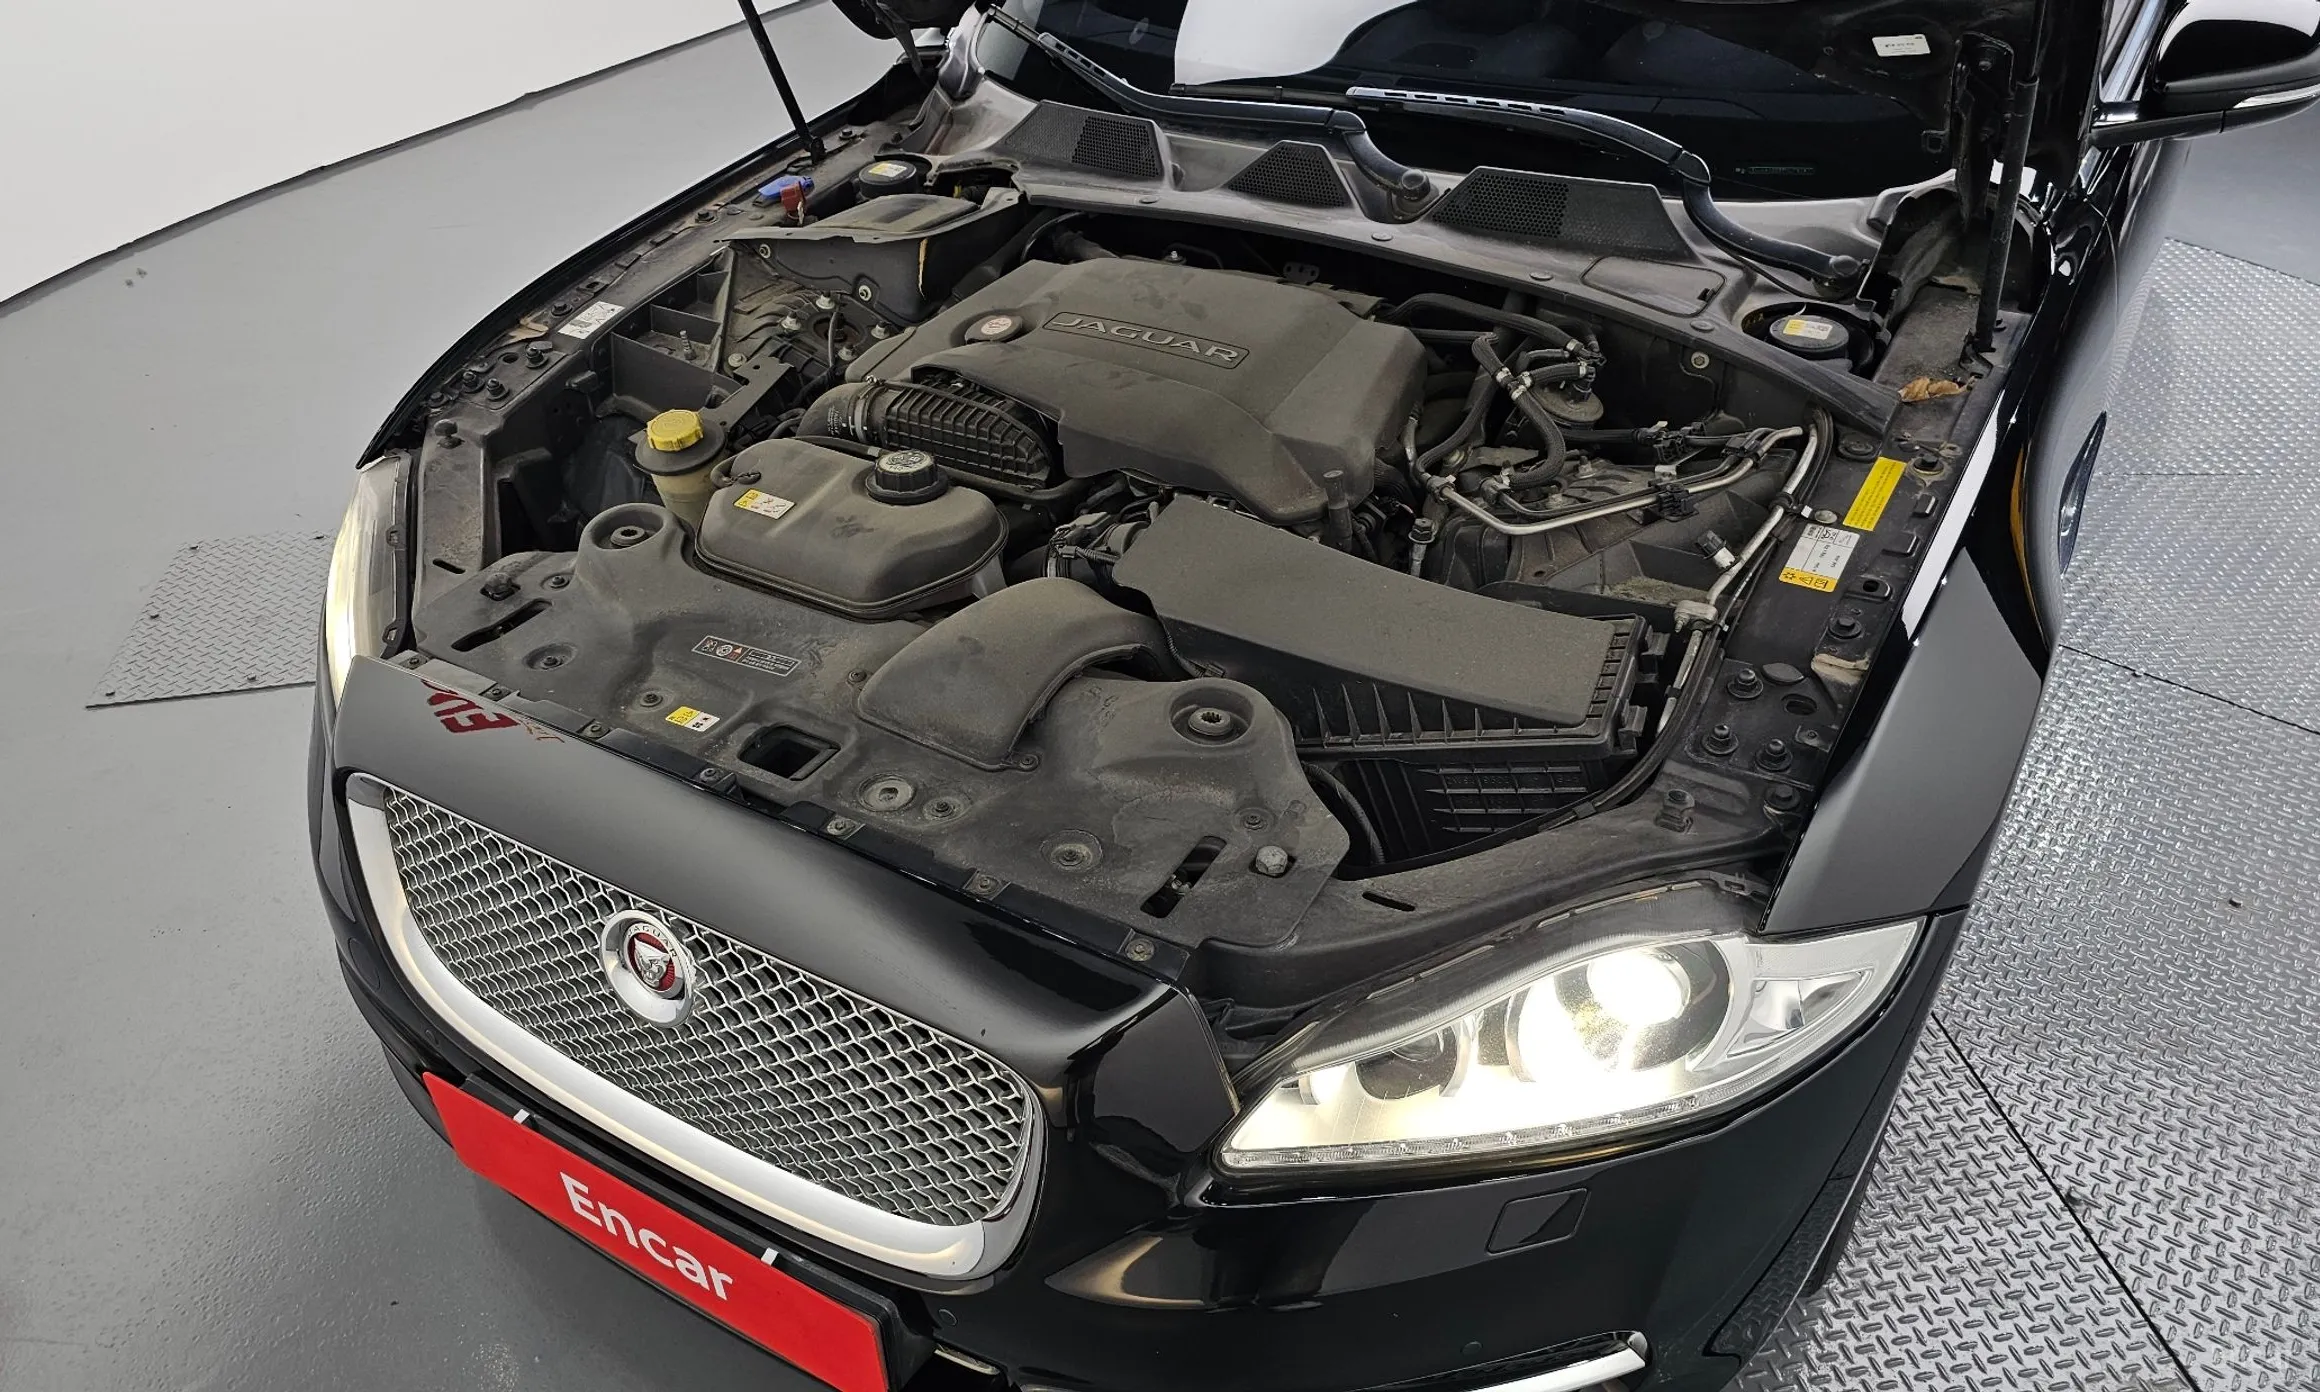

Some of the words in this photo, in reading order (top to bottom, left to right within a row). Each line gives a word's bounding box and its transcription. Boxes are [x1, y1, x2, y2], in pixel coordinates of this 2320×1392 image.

[1052, 318, 1239, 362] JAGUAR
[628, 925, 678, 958] JAGUAR
[559, 1171, 734, 1301] Encar
